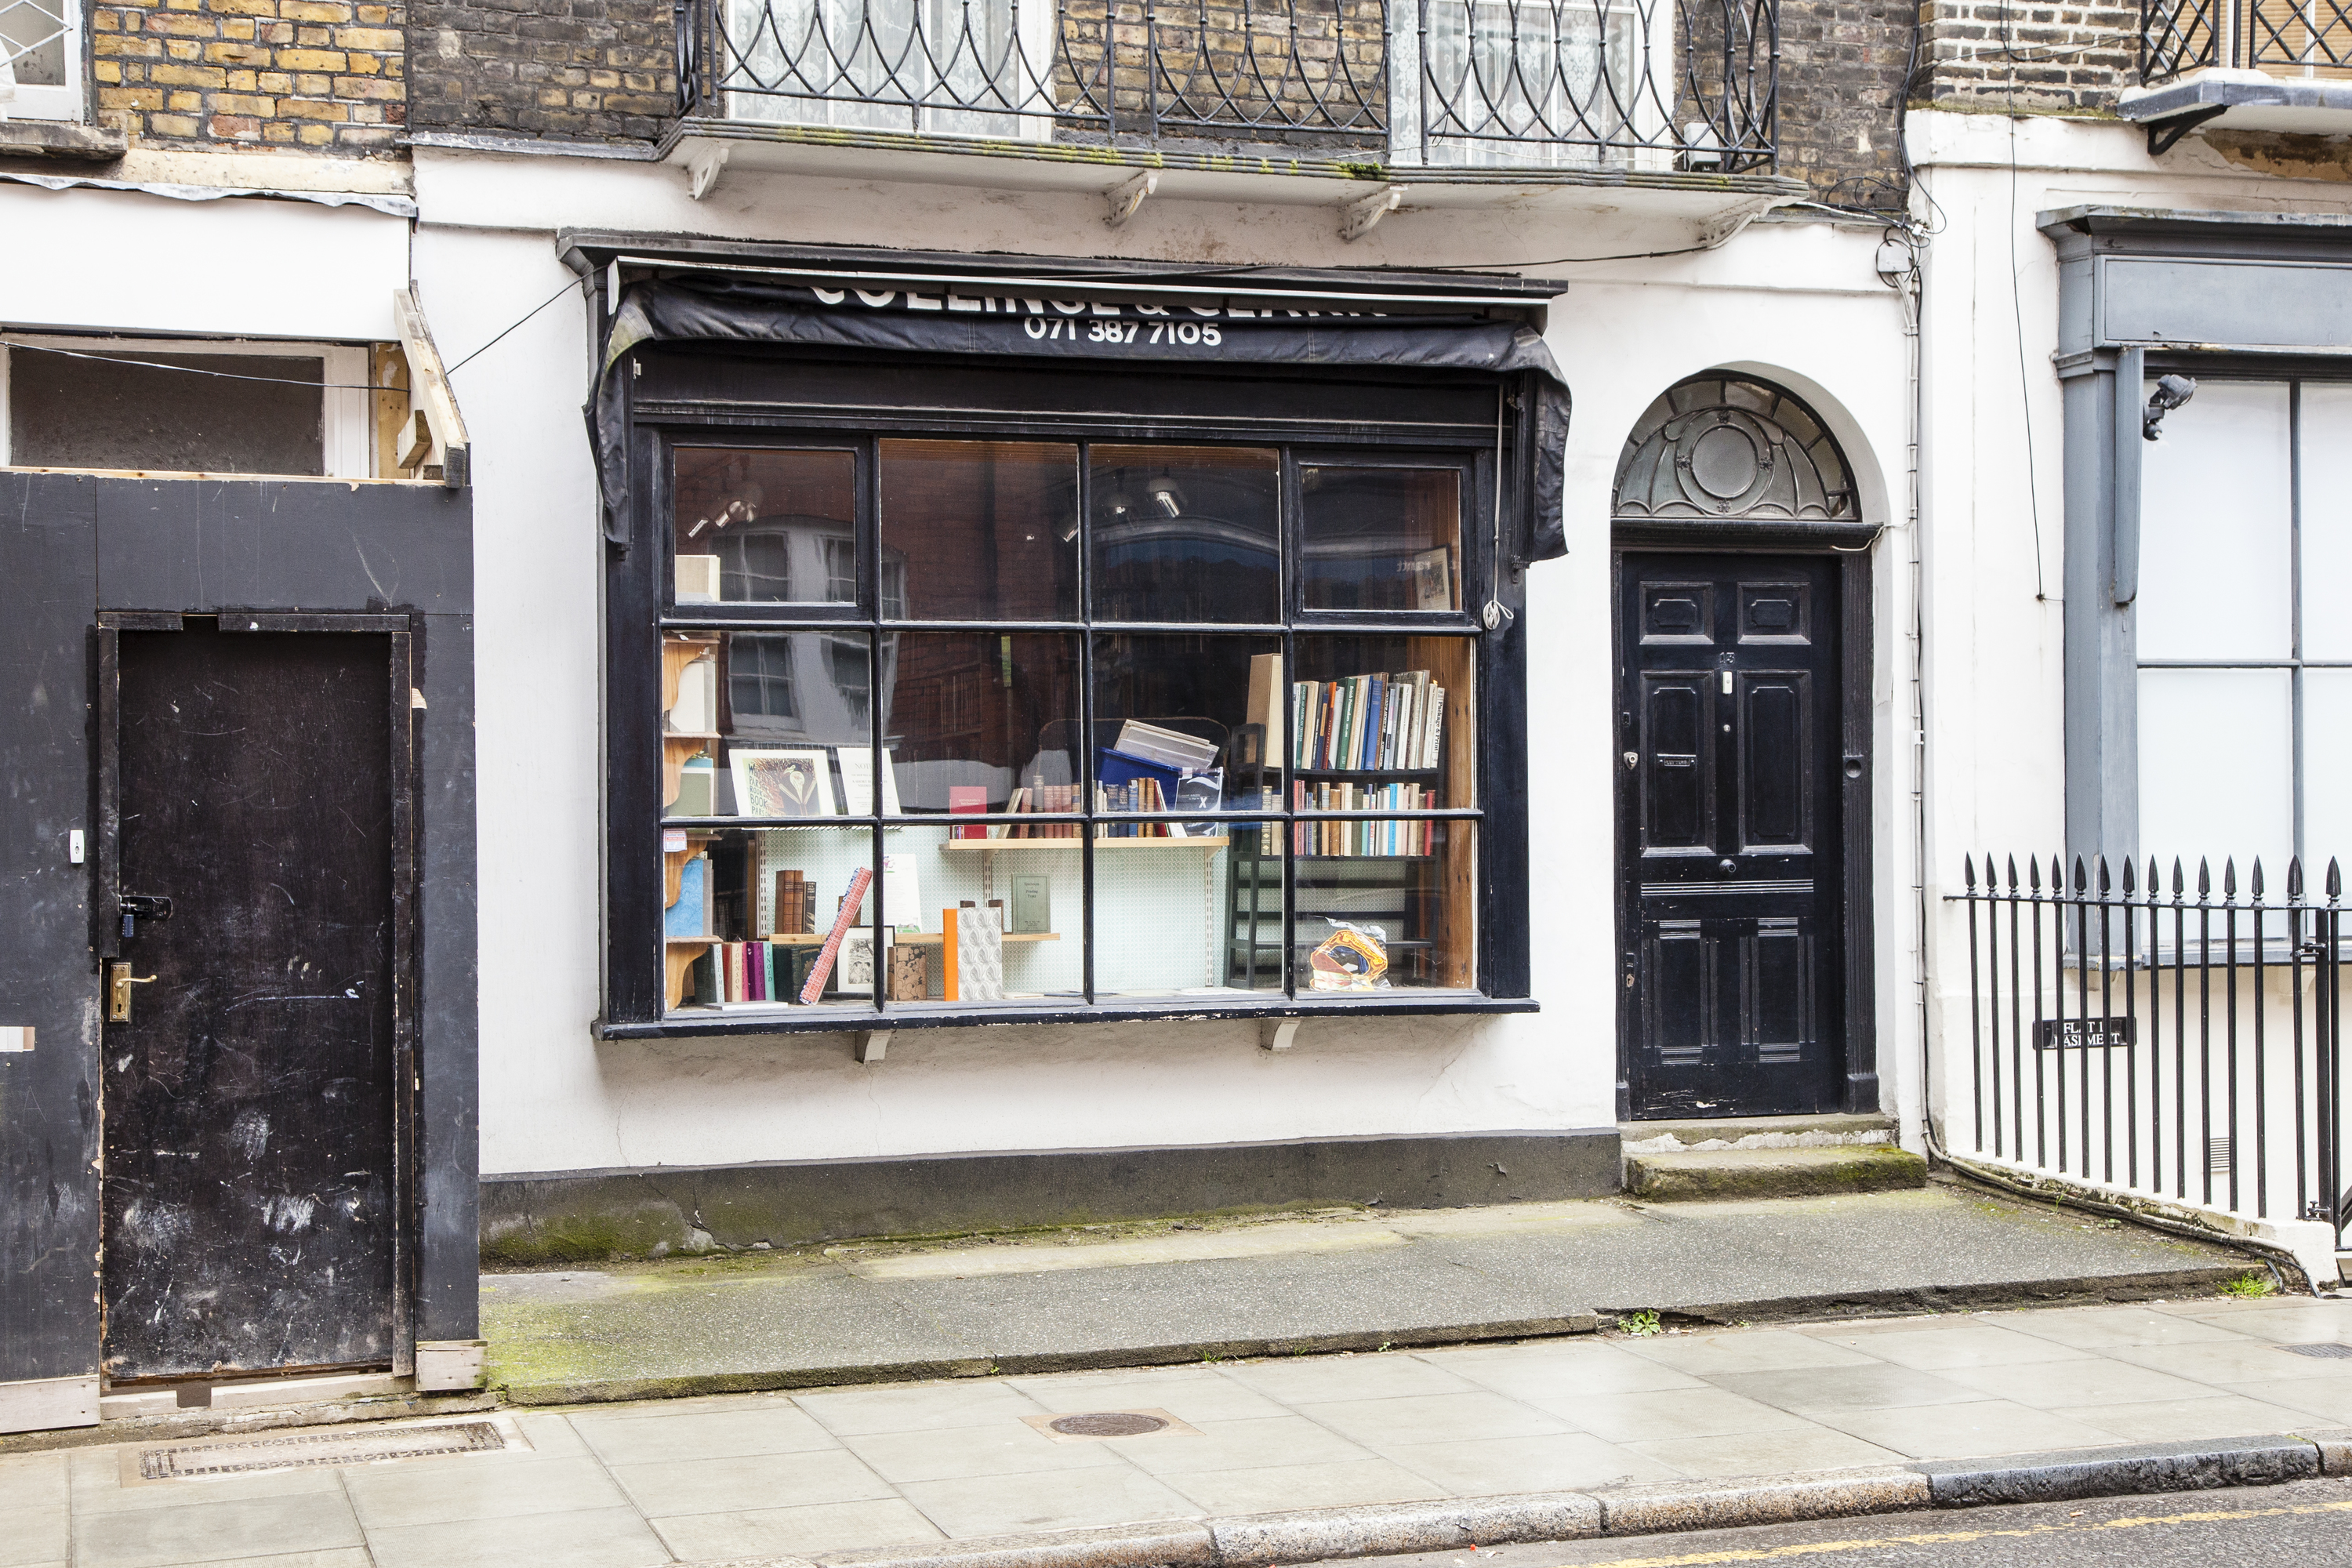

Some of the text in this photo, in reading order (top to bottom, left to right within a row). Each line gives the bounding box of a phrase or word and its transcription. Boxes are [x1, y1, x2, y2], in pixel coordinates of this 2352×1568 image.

[1024, 317, 1222, 347] 071 387 7105
[1719, 652, 1735, 664] 13
[750, 793, 768, 808] BOOK
[716, 948, 724, 1003] GOLDSMITH
[2063, 1021, 2096, 1034] FLT
[2054, 1033, 2120, 1047] ASMET
